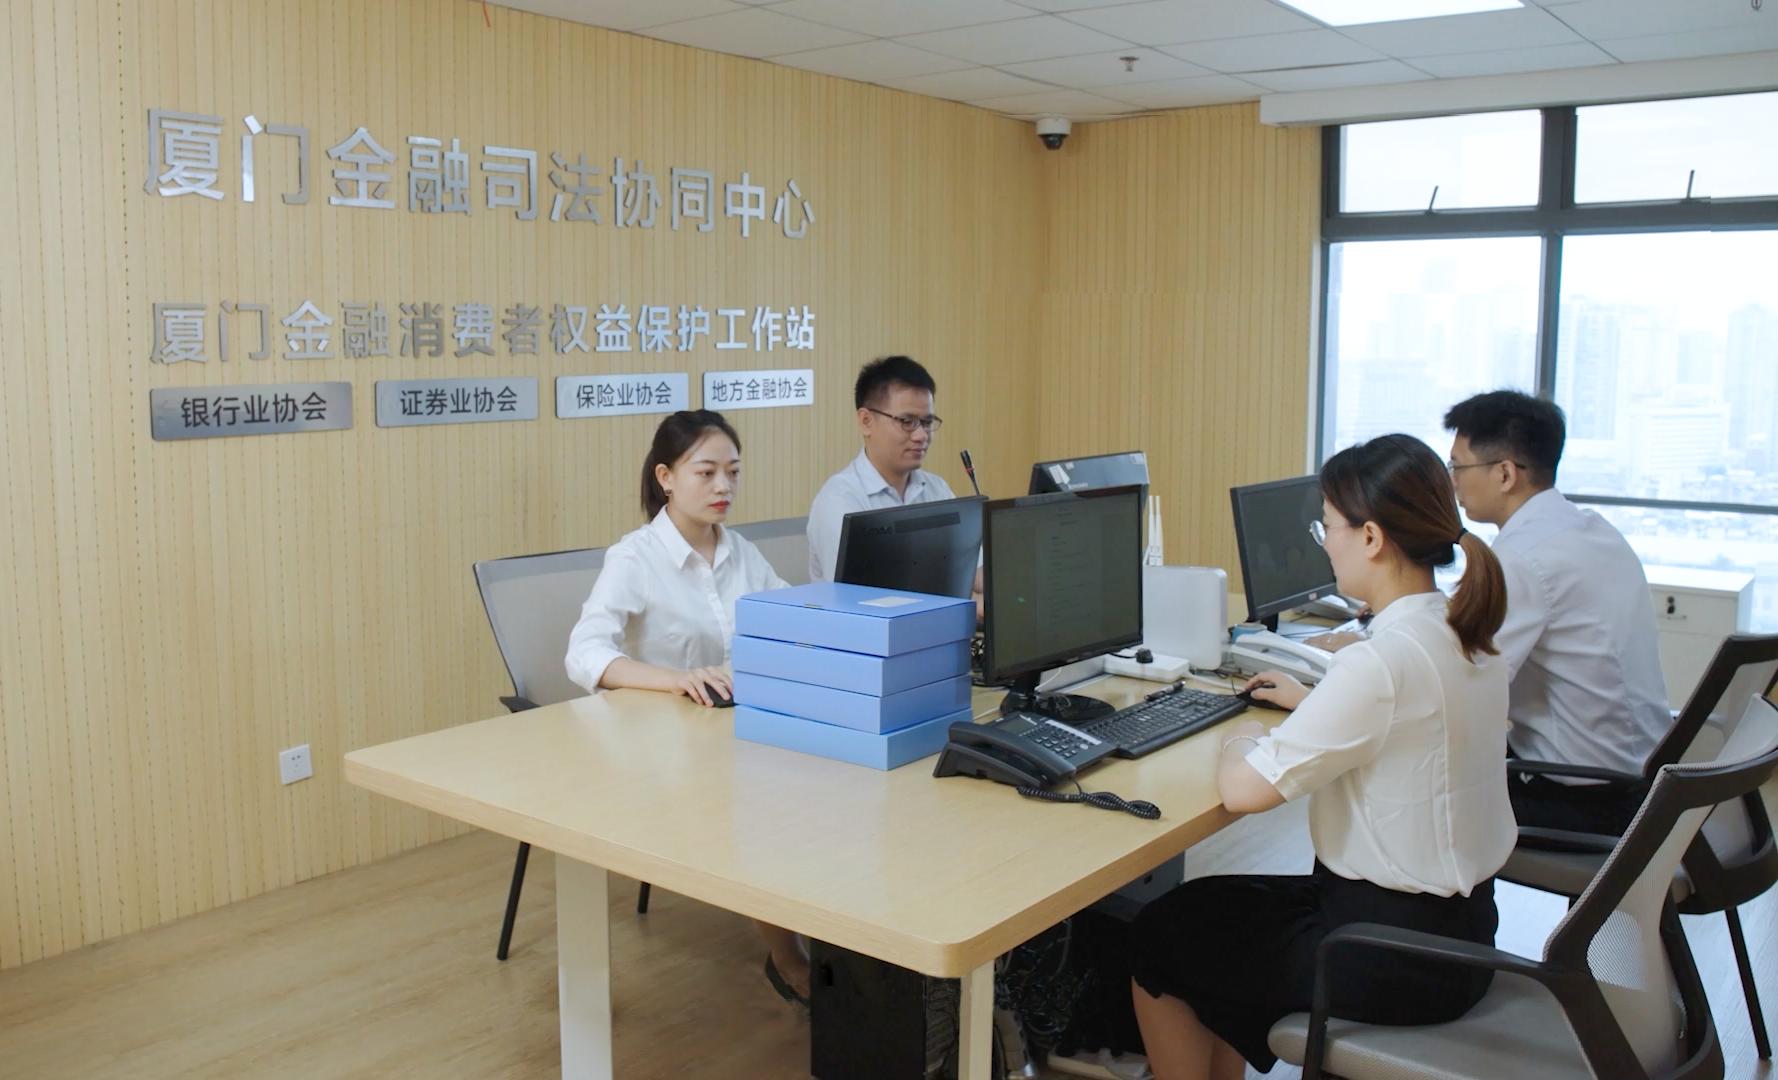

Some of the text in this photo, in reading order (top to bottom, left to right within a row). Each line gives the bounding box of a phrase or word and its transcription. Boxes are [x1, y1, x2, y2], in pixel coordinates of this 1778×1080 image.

[144, 108, 815, 238] 厦门金融司法协同中心
[150, 299, 816, 365] 厦门金融消费者权益保护工作站
[399, 387, 518, 418] 证券业协会
[576, 381, 672, 408] 保险业协会
[711, 377, 808, 403] 地方金融协会
[180, 392, 327, 428] 银行业协会
